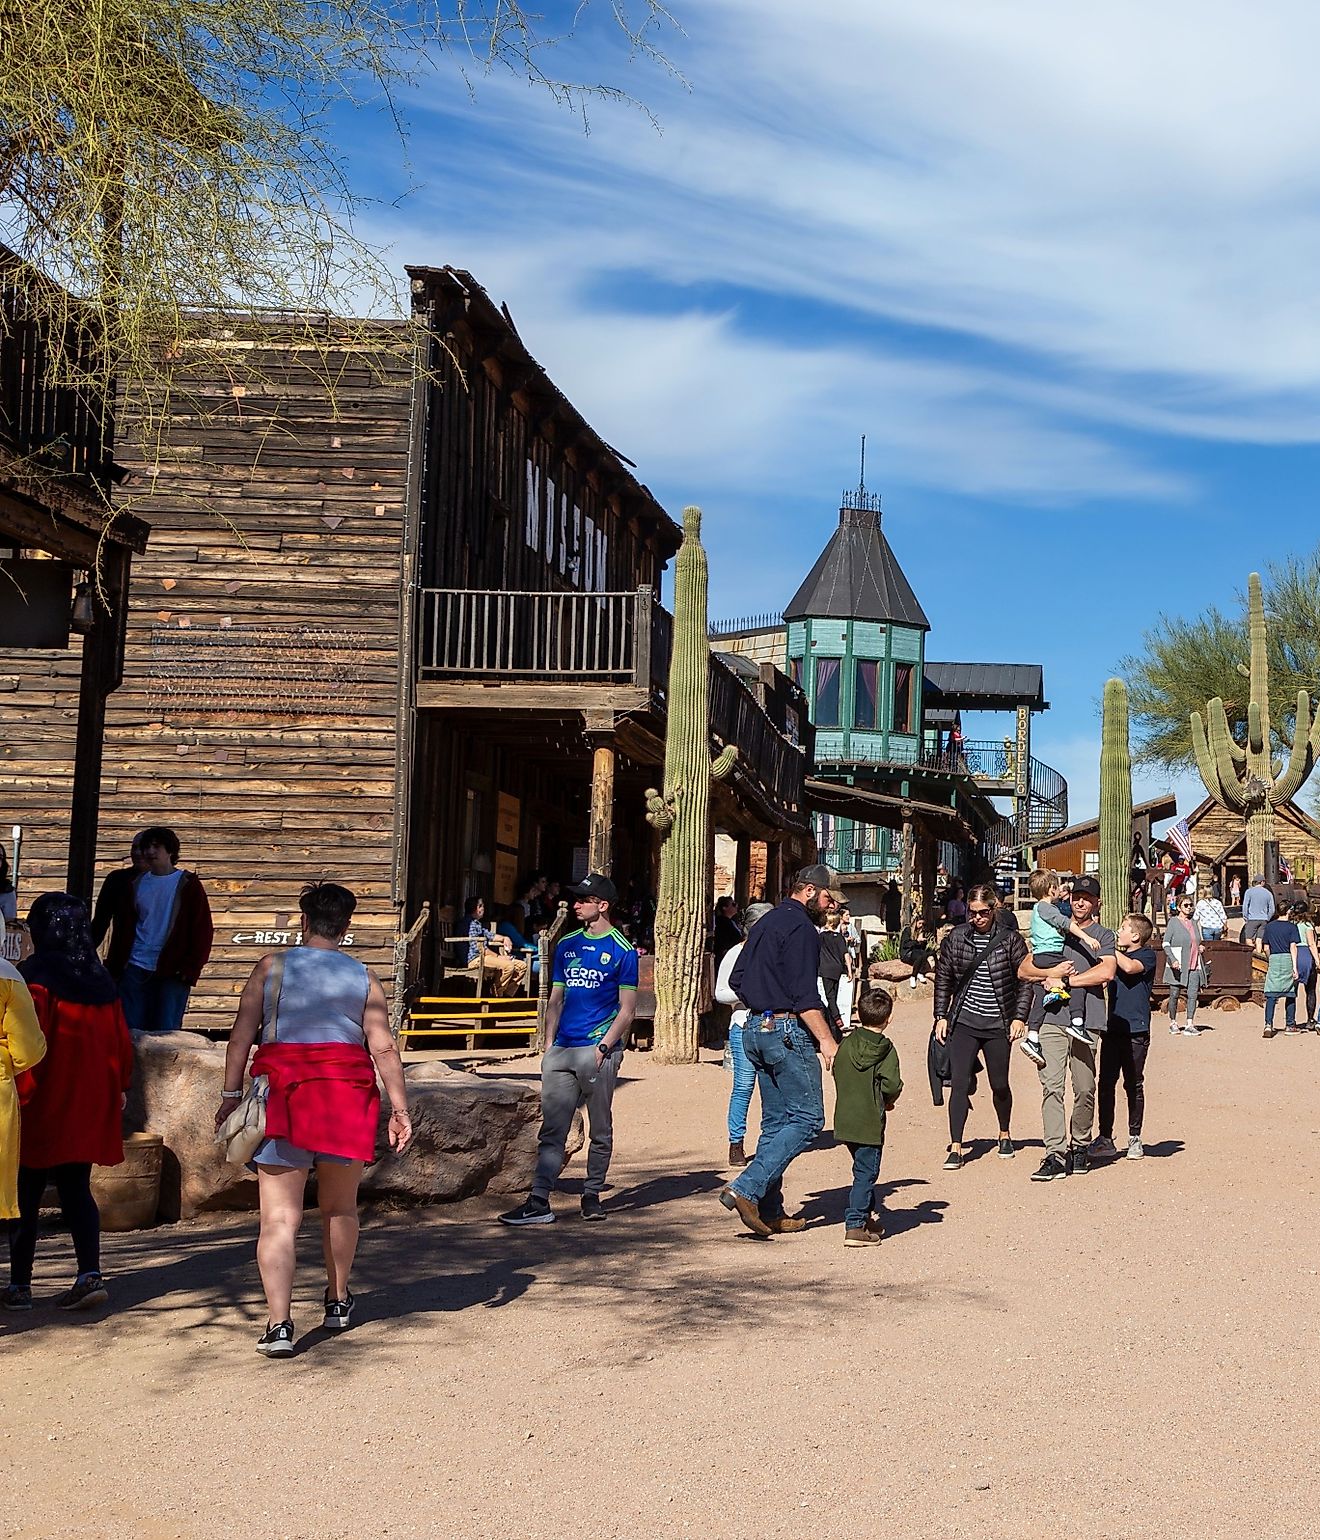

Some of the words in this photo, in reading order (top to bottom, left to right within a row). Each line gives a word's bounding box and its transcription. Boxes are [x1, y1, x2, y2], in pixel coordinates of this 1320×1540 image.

[525, 458, 607, 609] MUSEUM
[1017, 708, 1026, 794] BORDELLO
[255, 930, 291, 944] REST
[563, 967, 608, 982] KERRY
[566, 978, 600, 989] GROUP
